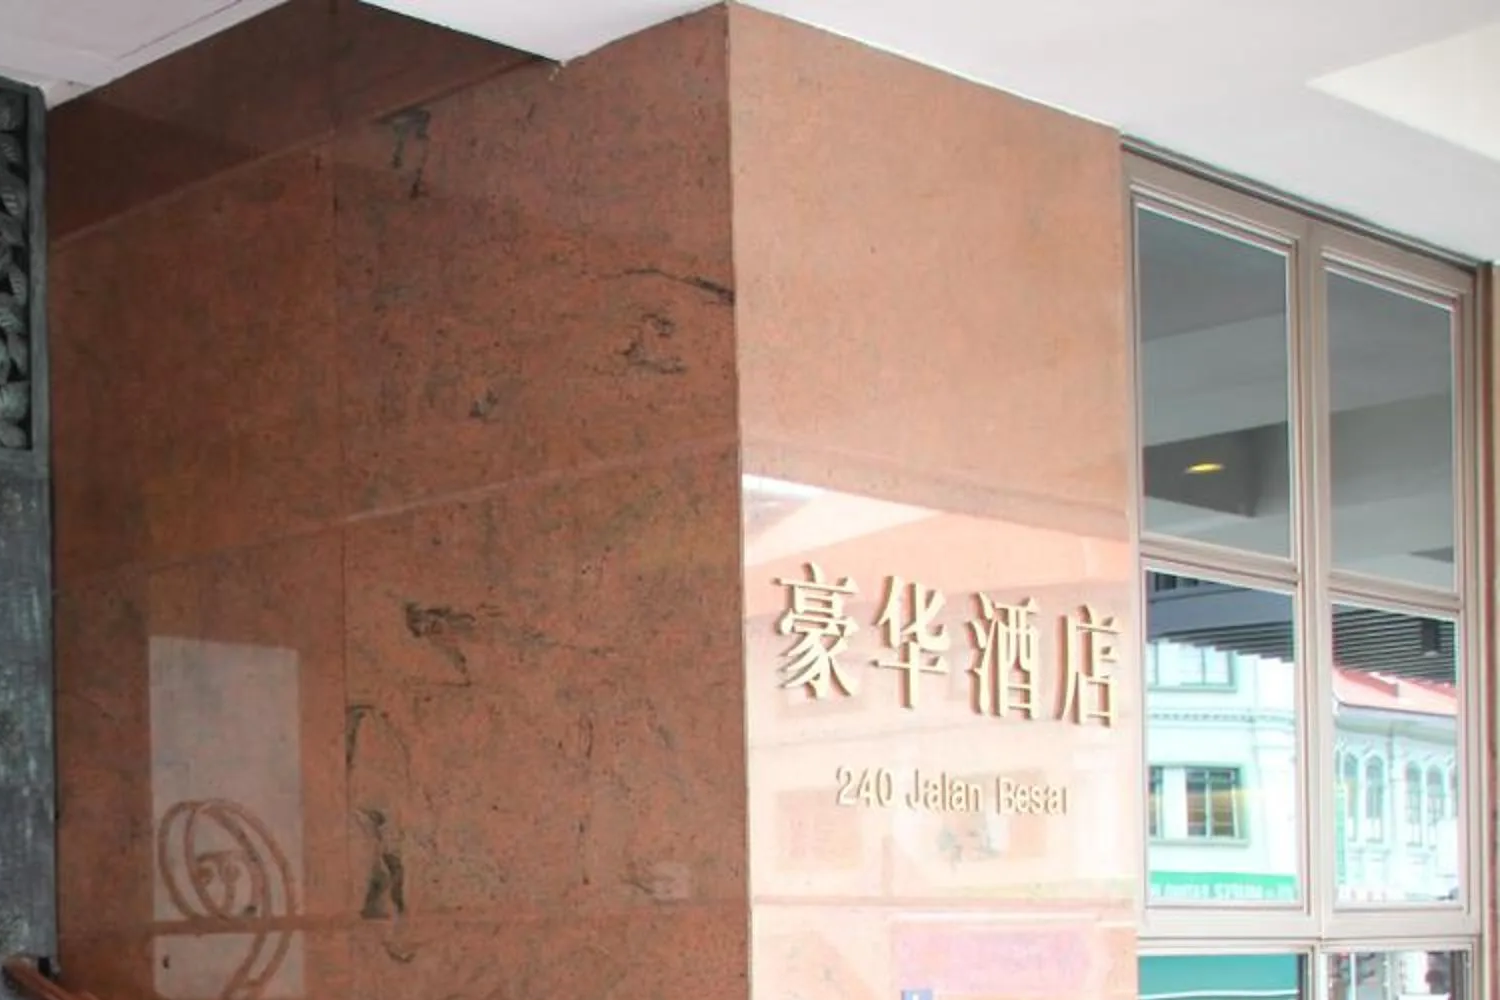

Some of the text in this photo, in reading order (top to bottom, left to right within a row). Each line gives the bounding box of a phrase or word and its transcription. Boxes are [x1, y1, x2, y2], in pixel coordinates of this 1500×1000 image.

[771, 561, 1122, 728] 豪华酒店
[835, 765, 894, 807] 240
[905, 768, 984, 813] Jalan
